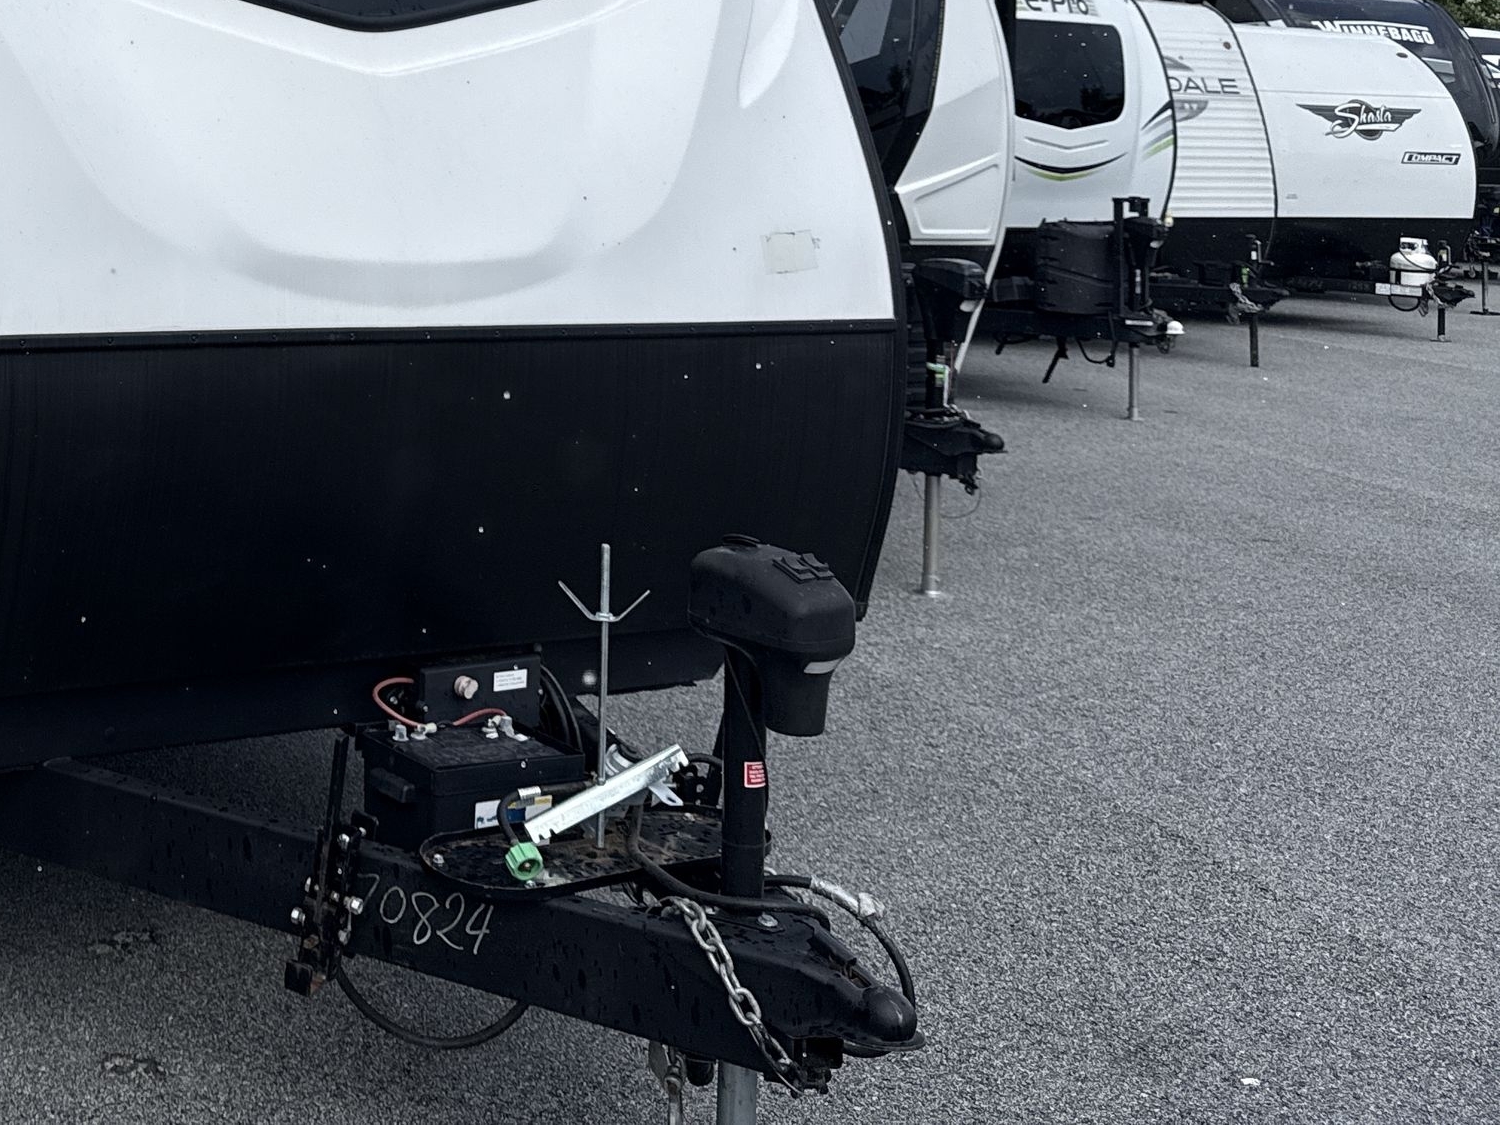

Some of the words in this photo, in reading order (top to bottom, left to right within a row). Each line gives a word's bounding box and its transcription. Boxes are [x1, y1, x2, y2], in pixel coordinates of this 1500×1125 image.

[1330, 102, 1394, 138] Shasta
[1403, 152, 1459, 164] COMPACT
[357, 873, 494, 955] 70824
